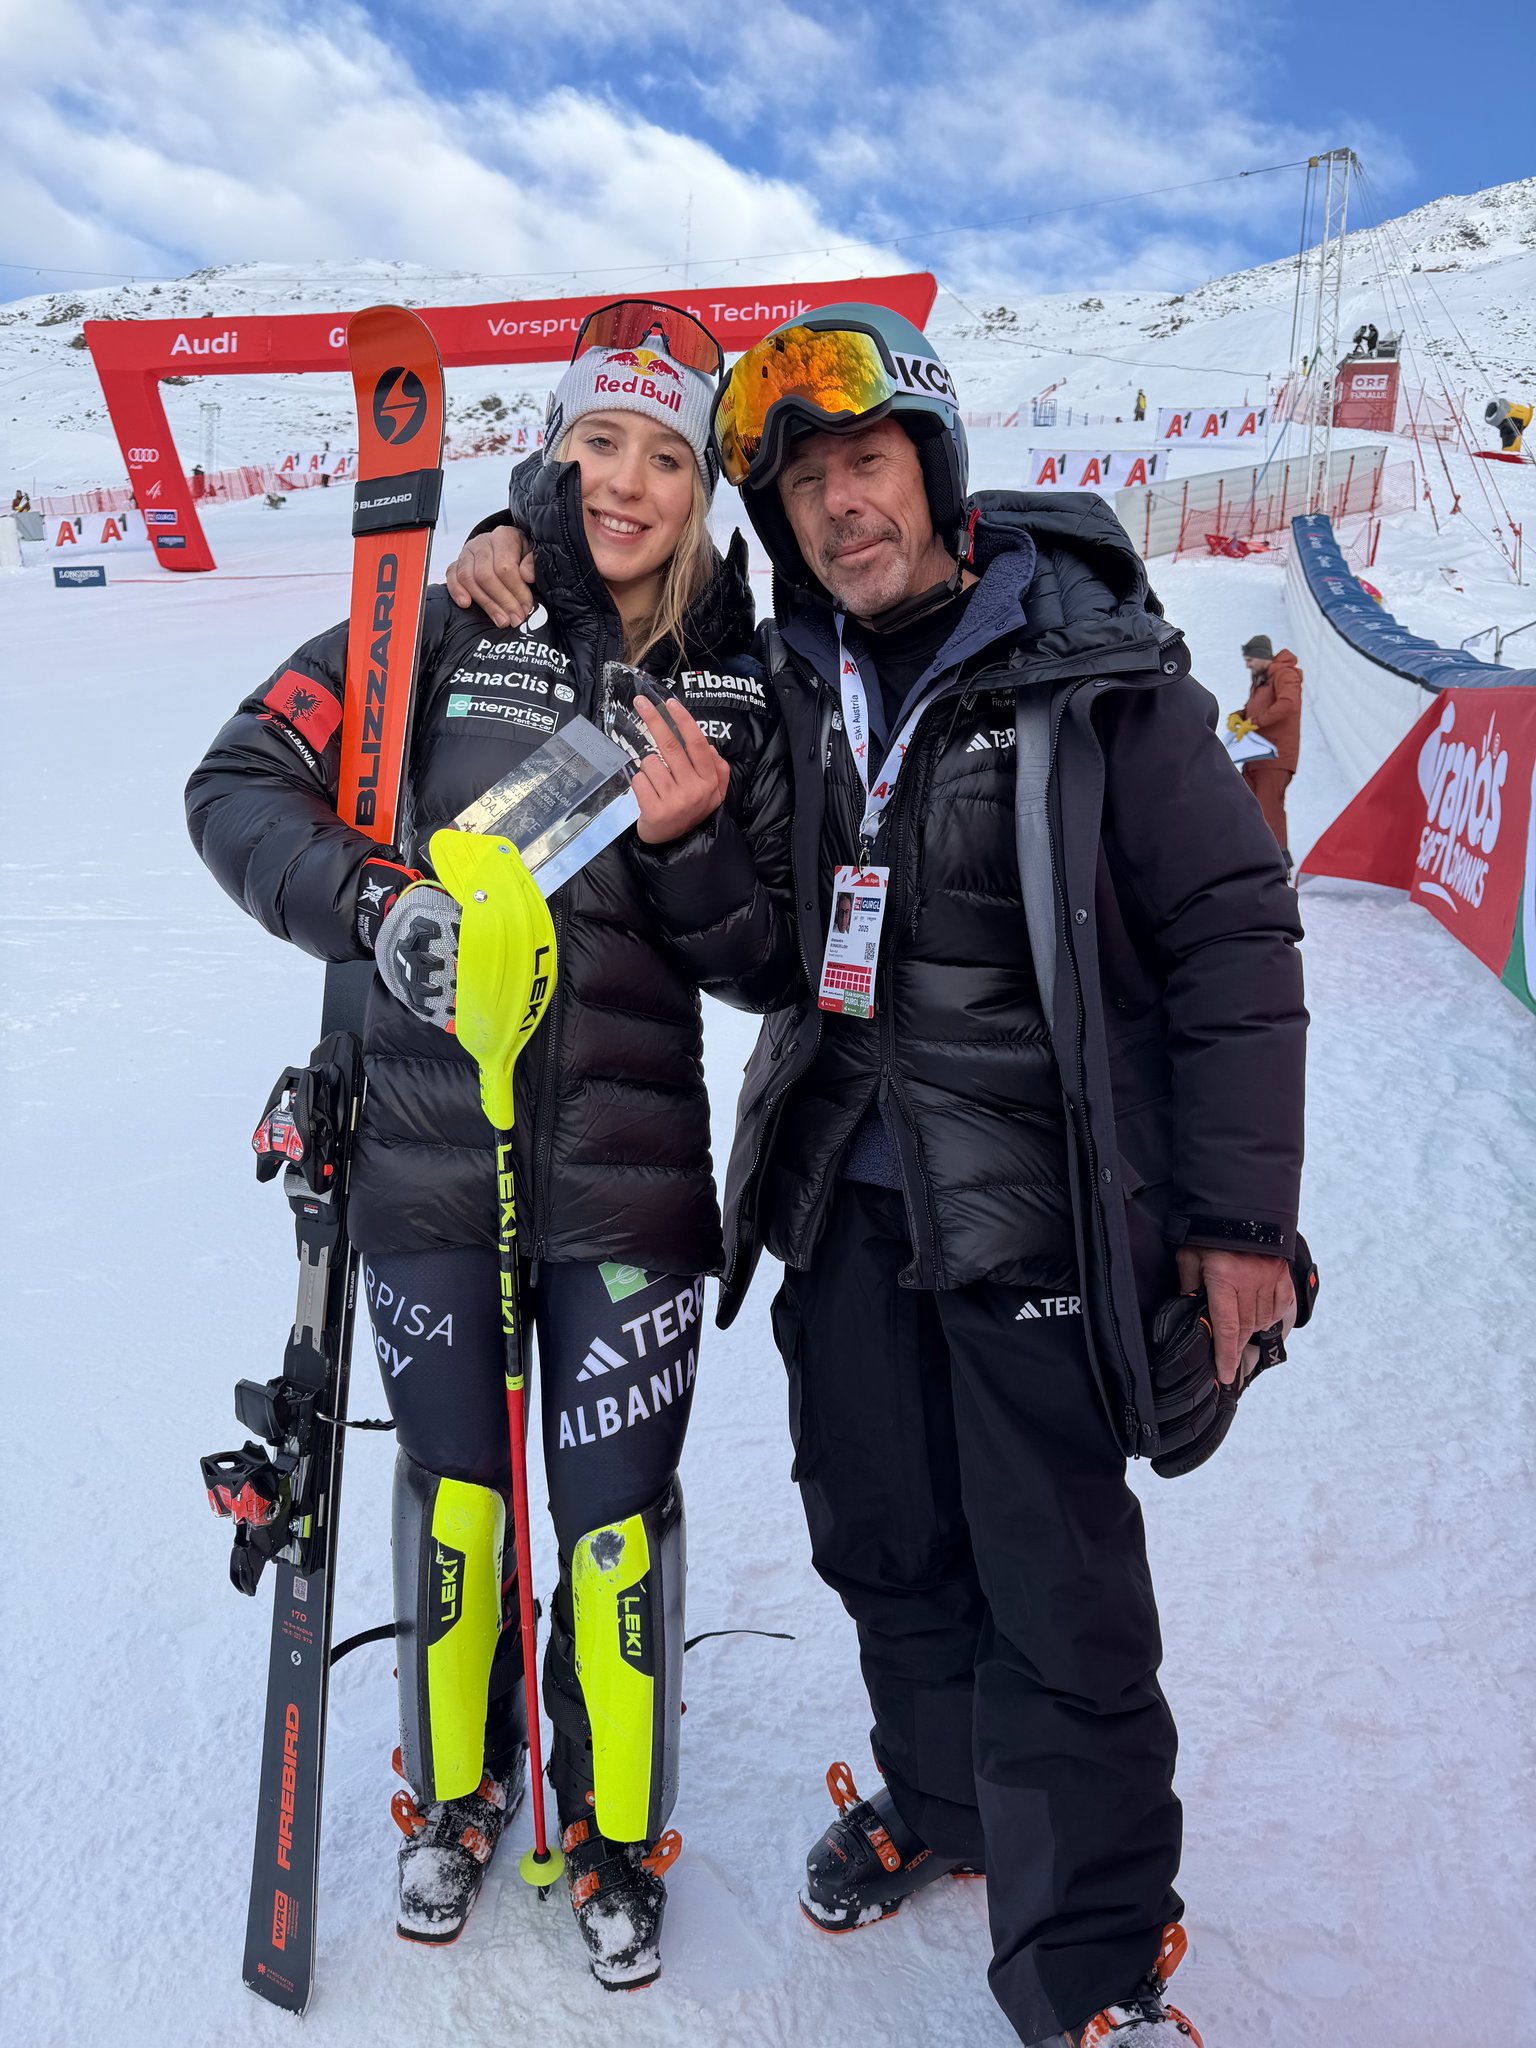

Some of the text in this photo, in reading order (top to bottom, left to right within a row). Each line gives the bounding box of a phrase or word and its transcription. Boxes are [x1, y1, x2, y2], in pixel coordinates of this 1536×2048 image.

[709, 300, 812, 322] Technik
[170, 331, 238, 356] Audi
[594, 374, 682, 413] Red Bull
[1355, 377, 1386, 387] ORF
[1165, 408, 1267, 438] A1 A1 A1
[281, 452, 300, 472] A1
[309, 452, 327, 472] A1
[1036, 454, 1157, 487] A1 A1 A1
[359, 493, 413, 509] BLIZZARD
[56, 513, 128, 547] A1 A1
[354, 553, 399, 826] BLIZZARD
[450, 668, 549, 695] SanaClis
[681, 670, 766, 698] Fibank
[451, 700, 555, 727] enterprise
[685, 690, 767, 708] First Investment Bank
[851, 694, 860, 722] Austria
[283, 729, 316, 768] ALBANIA
[520, 762, 552, 789] WOMENS
[546, 783, 573, 808] SLALOM
[540, 792, 556, 807] 2025
[862, 900, 881, 910] GURGL
[518, 945, 550, 1033] LEKI
[497, 1142, 517, 1239] LEKI
[1041, 1296, 1082, 1317] TER
[559, 1347, 696, 1449] ALBANIA
[440, 1559, 458, 1622] LEKI
[291, 1609, 307, 1623] 170
[624, 1596, 642, 1657] LEKI
[277, 1703, 299, 1871] FIREBIRD
[275, 1895, 285, 1940] WRC
